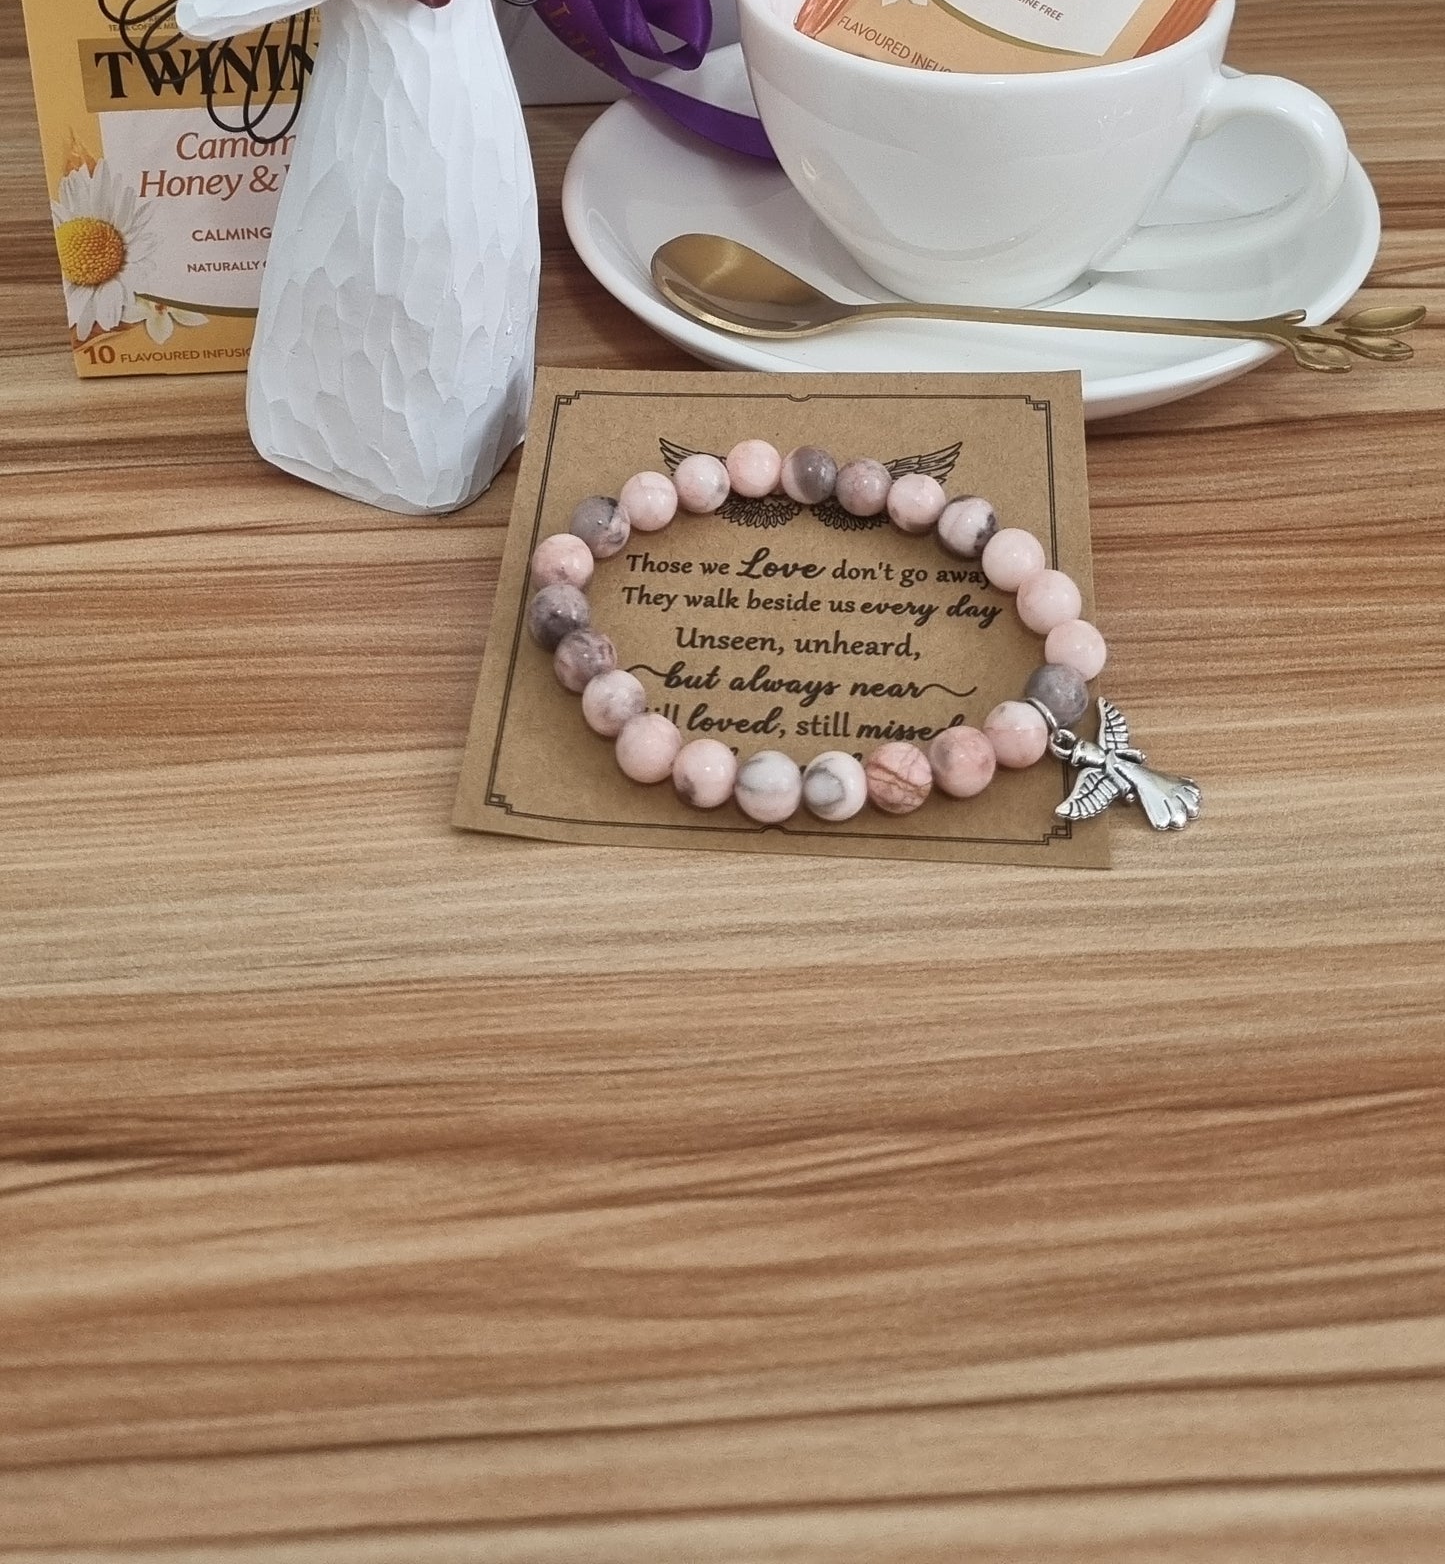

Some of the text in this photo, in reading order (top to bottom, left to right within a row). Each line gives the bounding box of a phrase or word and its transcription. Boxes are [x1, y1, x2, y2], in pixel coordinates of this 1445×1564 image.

[1039, 4, 1065, 21] FREE
[837, 15, 911, 60] FLAVOURED
[94, 42, 319, 99] TWININ
[139, 165, 279, 201] Honey &
[191, 226, 272, 242] CALMING
[187, 260, 260, 273] NATURALLY
[83, 345, 116, 365] 10
[120, 350, 200, 364] FLAVOURED
[626, 552, 693, 574] Those
[699, 561, 731, 575] we
[736, 547, 826, 579] Love
[832, 559, 895, 581] don't
[900, 568, 928, 588] go
[622, 584, 1003, 629] They walk beside us every day
[675, 626, 921, 661] Unseen, unheard,
[663, 660, 927, 708] but always near
[687, 703, 786, 738] loved,
[795, 711, 851, 737] still
